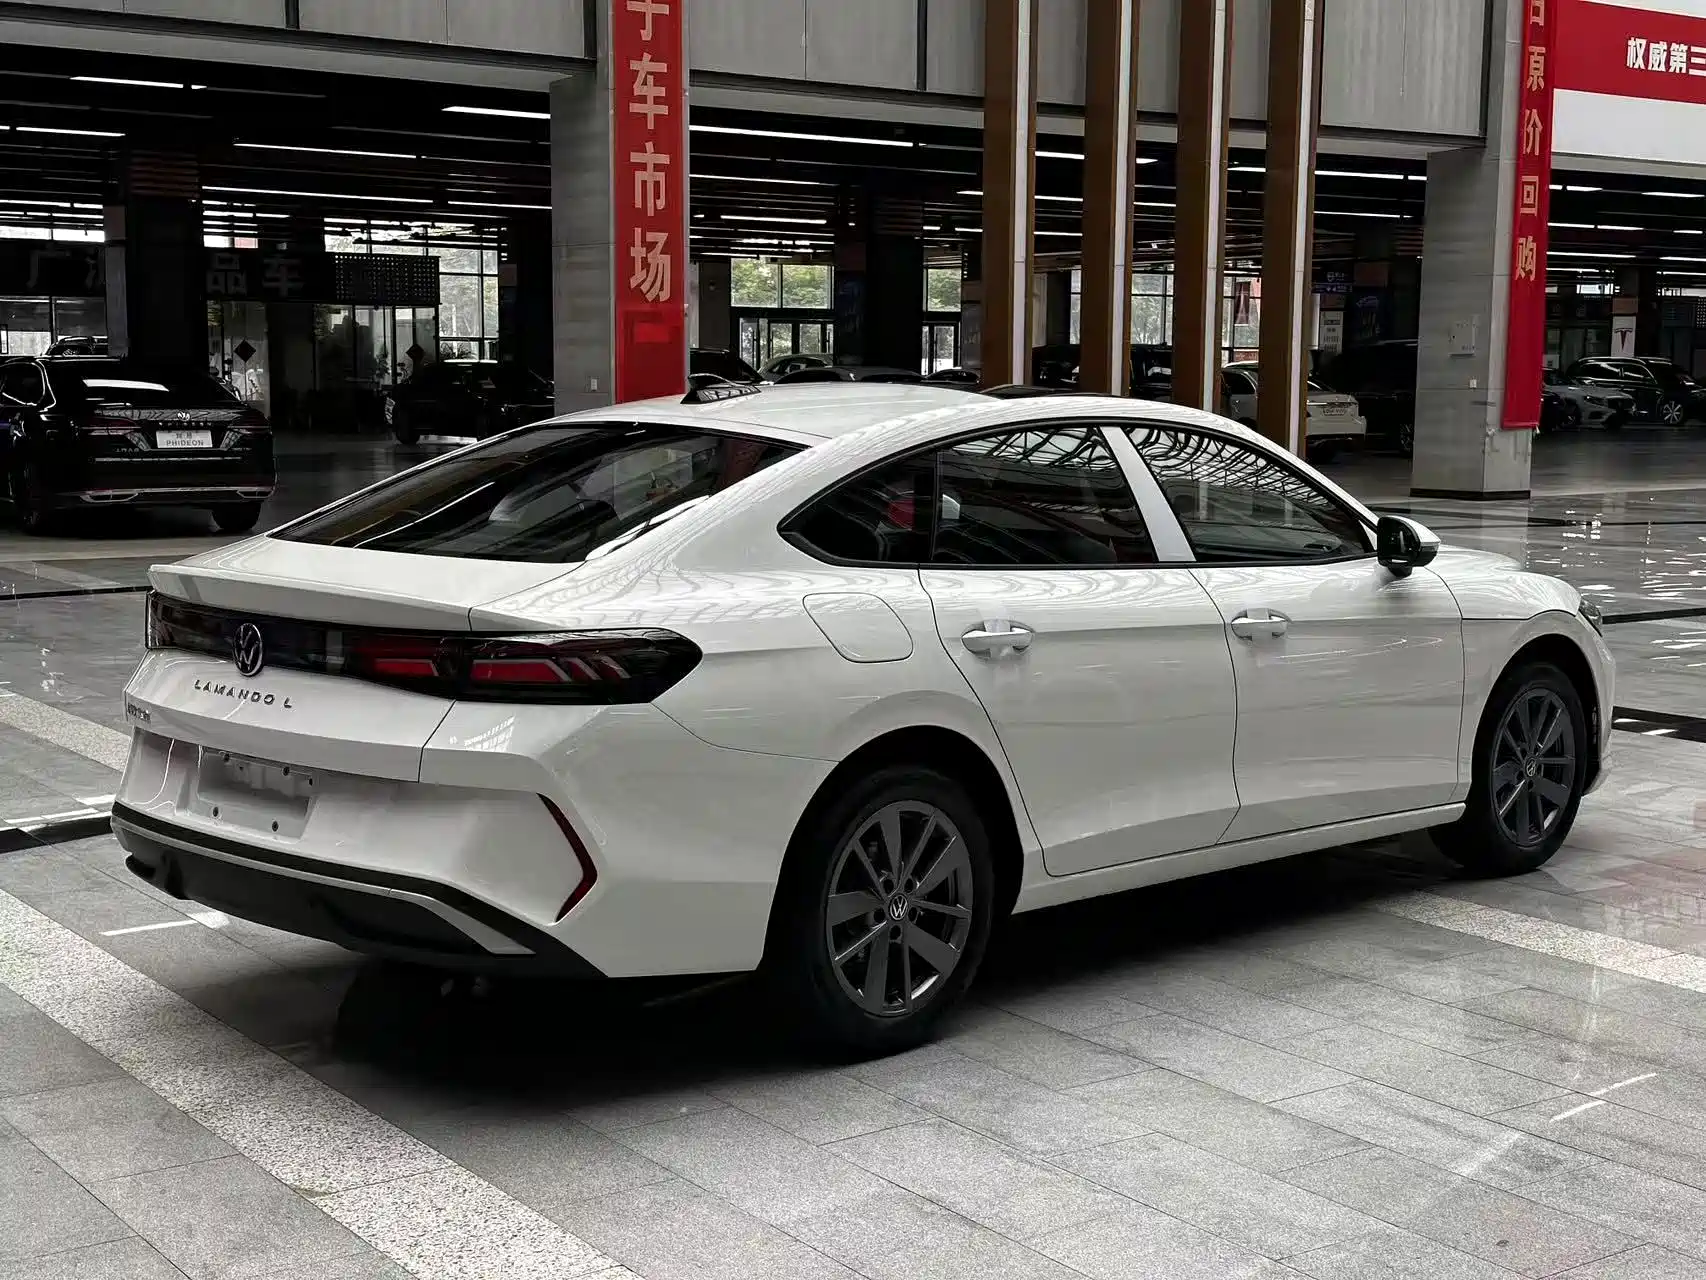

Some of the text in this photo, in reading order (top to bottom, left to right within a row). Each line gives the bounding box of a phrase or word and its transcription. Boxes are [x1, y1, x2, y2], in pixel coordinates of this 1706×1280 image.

[1626, 36, 1706, 77] 权威第三
[194, 679, 292, 708] LAMANDO L
